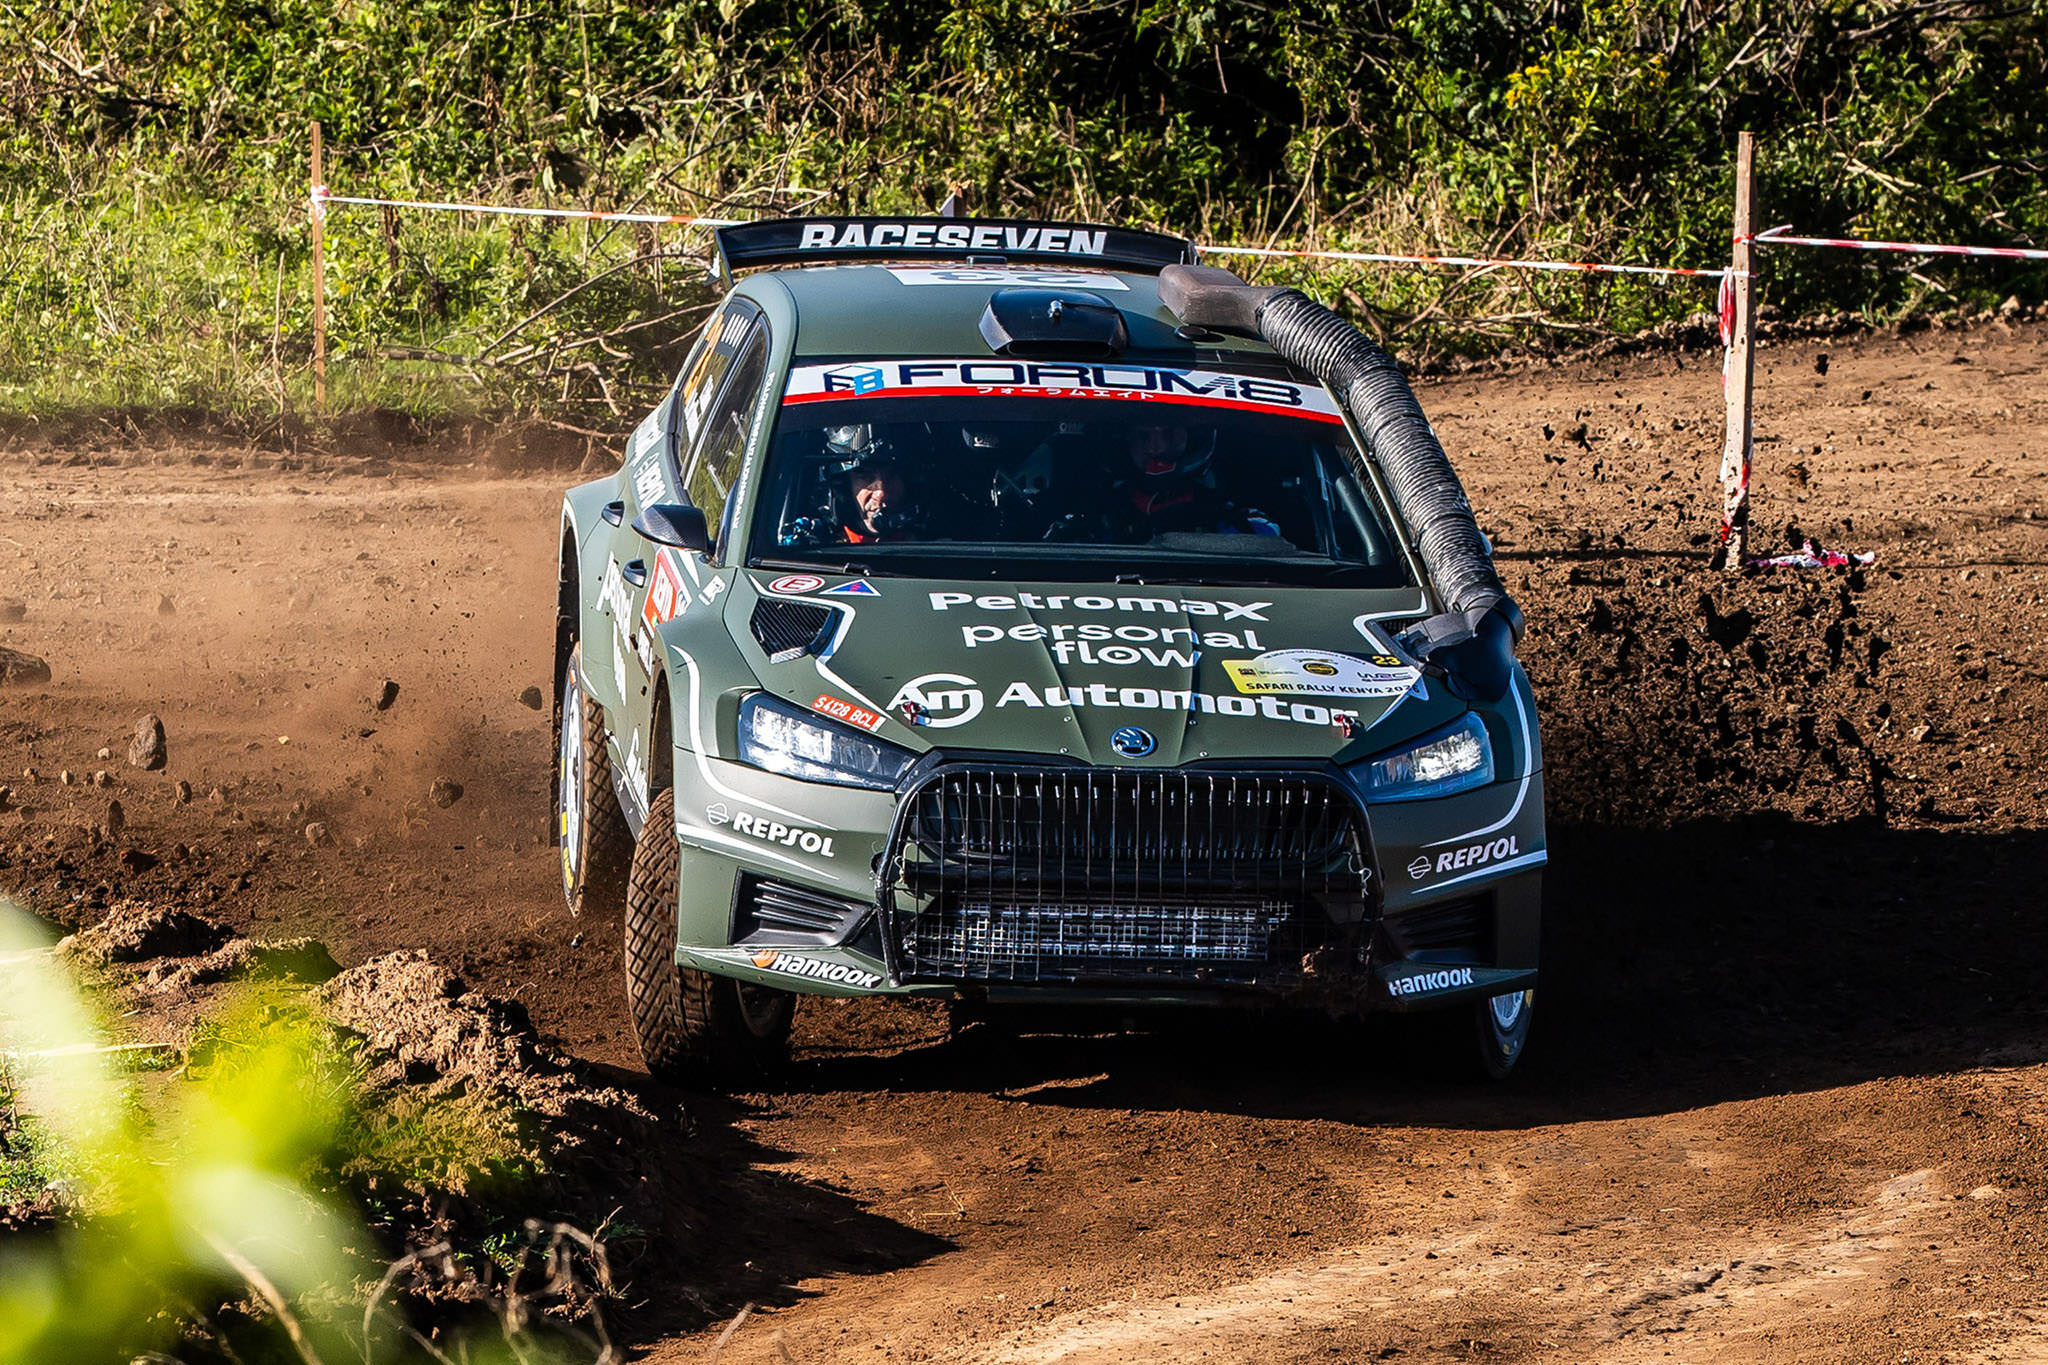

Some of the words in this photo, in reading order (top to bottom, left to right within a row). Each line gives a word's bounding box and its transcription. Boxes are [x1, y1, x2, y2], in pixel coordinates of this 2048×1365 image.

[799, 223, 1107, 256] RACESEVEN
[898, 363, 1303, 407] FORUM8
[976, 386, 1155, 400] フォーラムエイト
[961, 623, 1267, 652] personal
[1051, 641, 1203, 669] flow
[1372, 655, 1402, 666] 23
[1246, 682, 1294, 691] SAFARI
[1296, 683, 1336, 693] RALLY
[1338, 686, 1384, 694] KENYA
[815, 696, 851, 717] S4128
[849, 709, 874, 728] BCL
[995, 682, 1360, 728] Automotor
[733, 811, 835, 858] REPSOL
[1435, 835, 1520, 873] REPSOL
